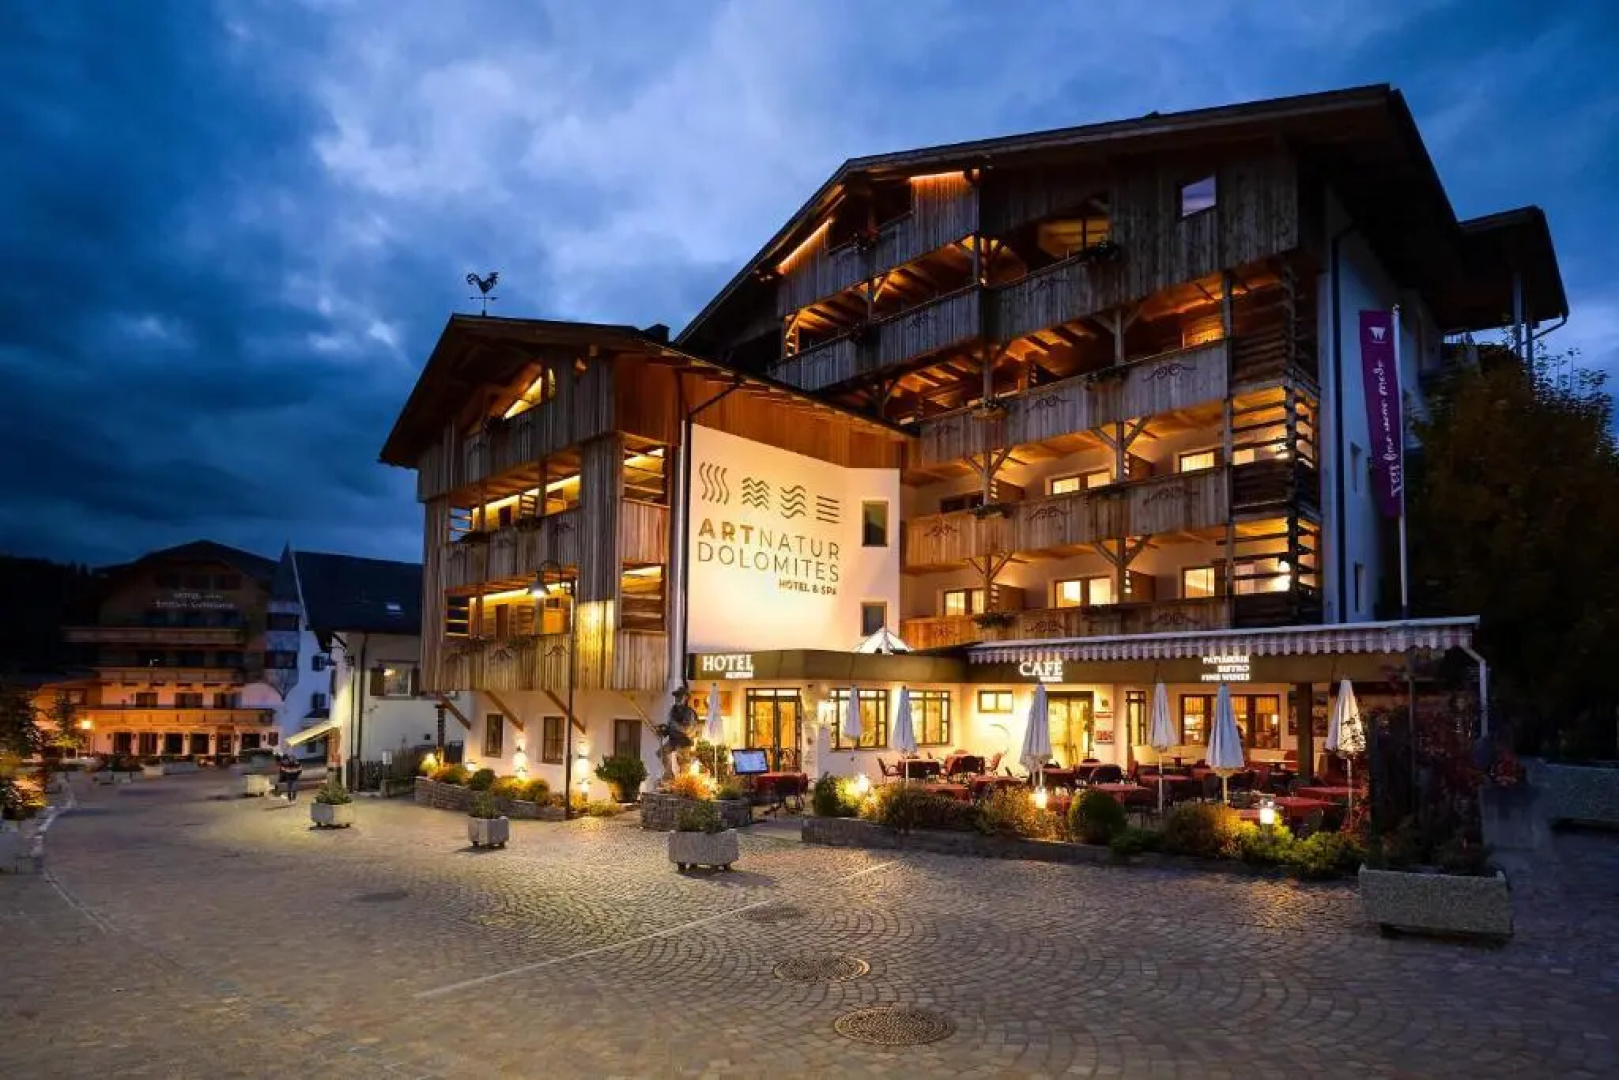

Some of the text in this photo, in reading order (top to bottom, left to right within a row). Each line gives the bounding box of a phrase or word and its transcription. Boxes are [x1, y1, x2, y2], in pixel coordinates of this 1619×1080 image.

[698, 541, 839, 582] DOLOMITES
[779, 578, 837, 595] HOTEL & SPA
[702, 654, 753, 671] HOTEL
